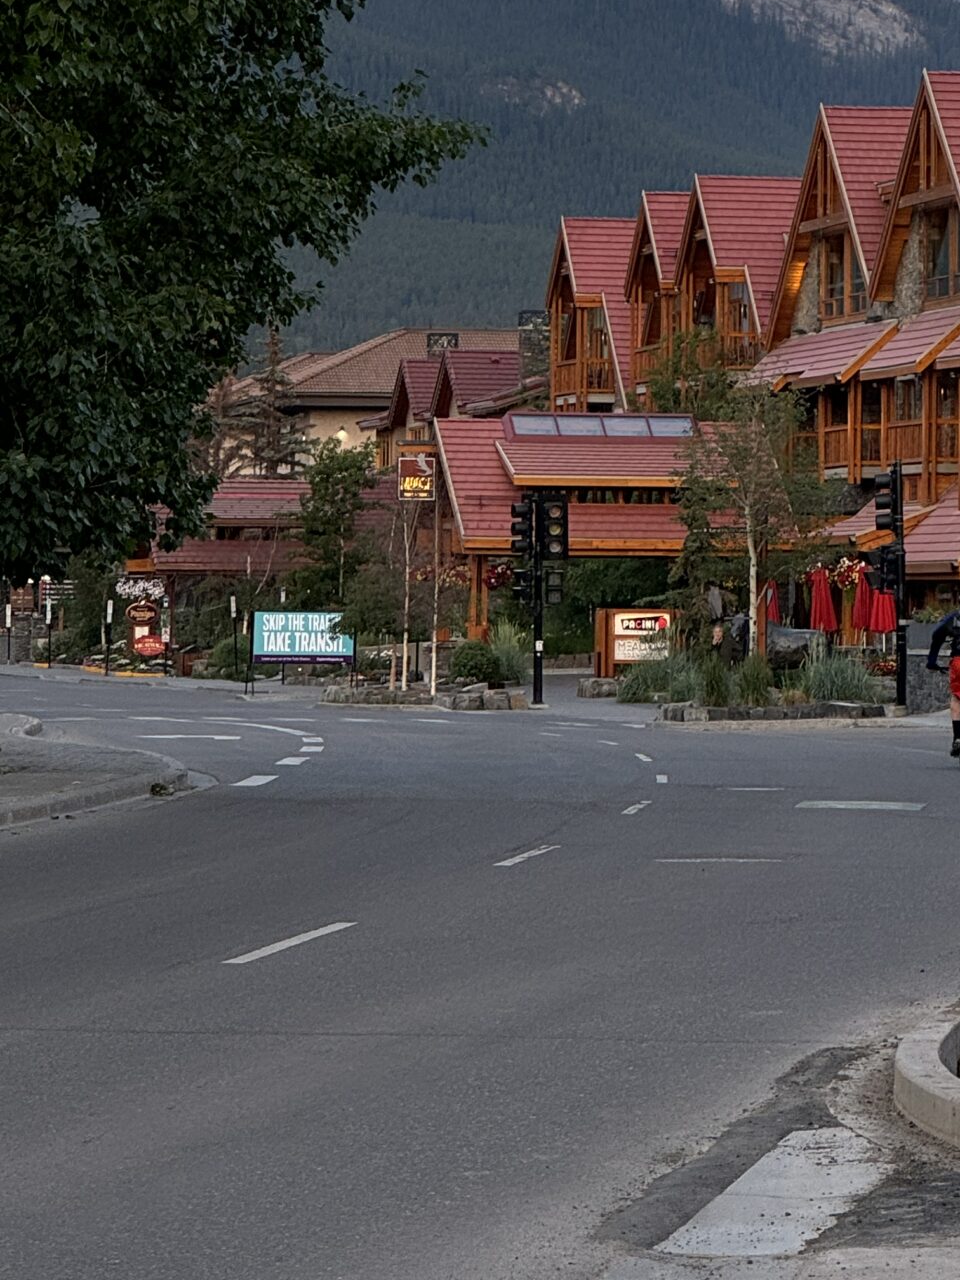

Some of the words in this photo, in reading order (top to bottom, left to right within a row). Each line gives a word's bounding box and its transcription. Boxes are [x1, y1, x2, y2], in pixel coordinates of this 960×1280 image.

[262, 615, 285, 631] SKIP
[288, 615, 304, 631] THE
[308, 615, 342, 631] TRAF
[623, 620, 655, 629] PACINI
[262, 632, 291, 651] TAKE
